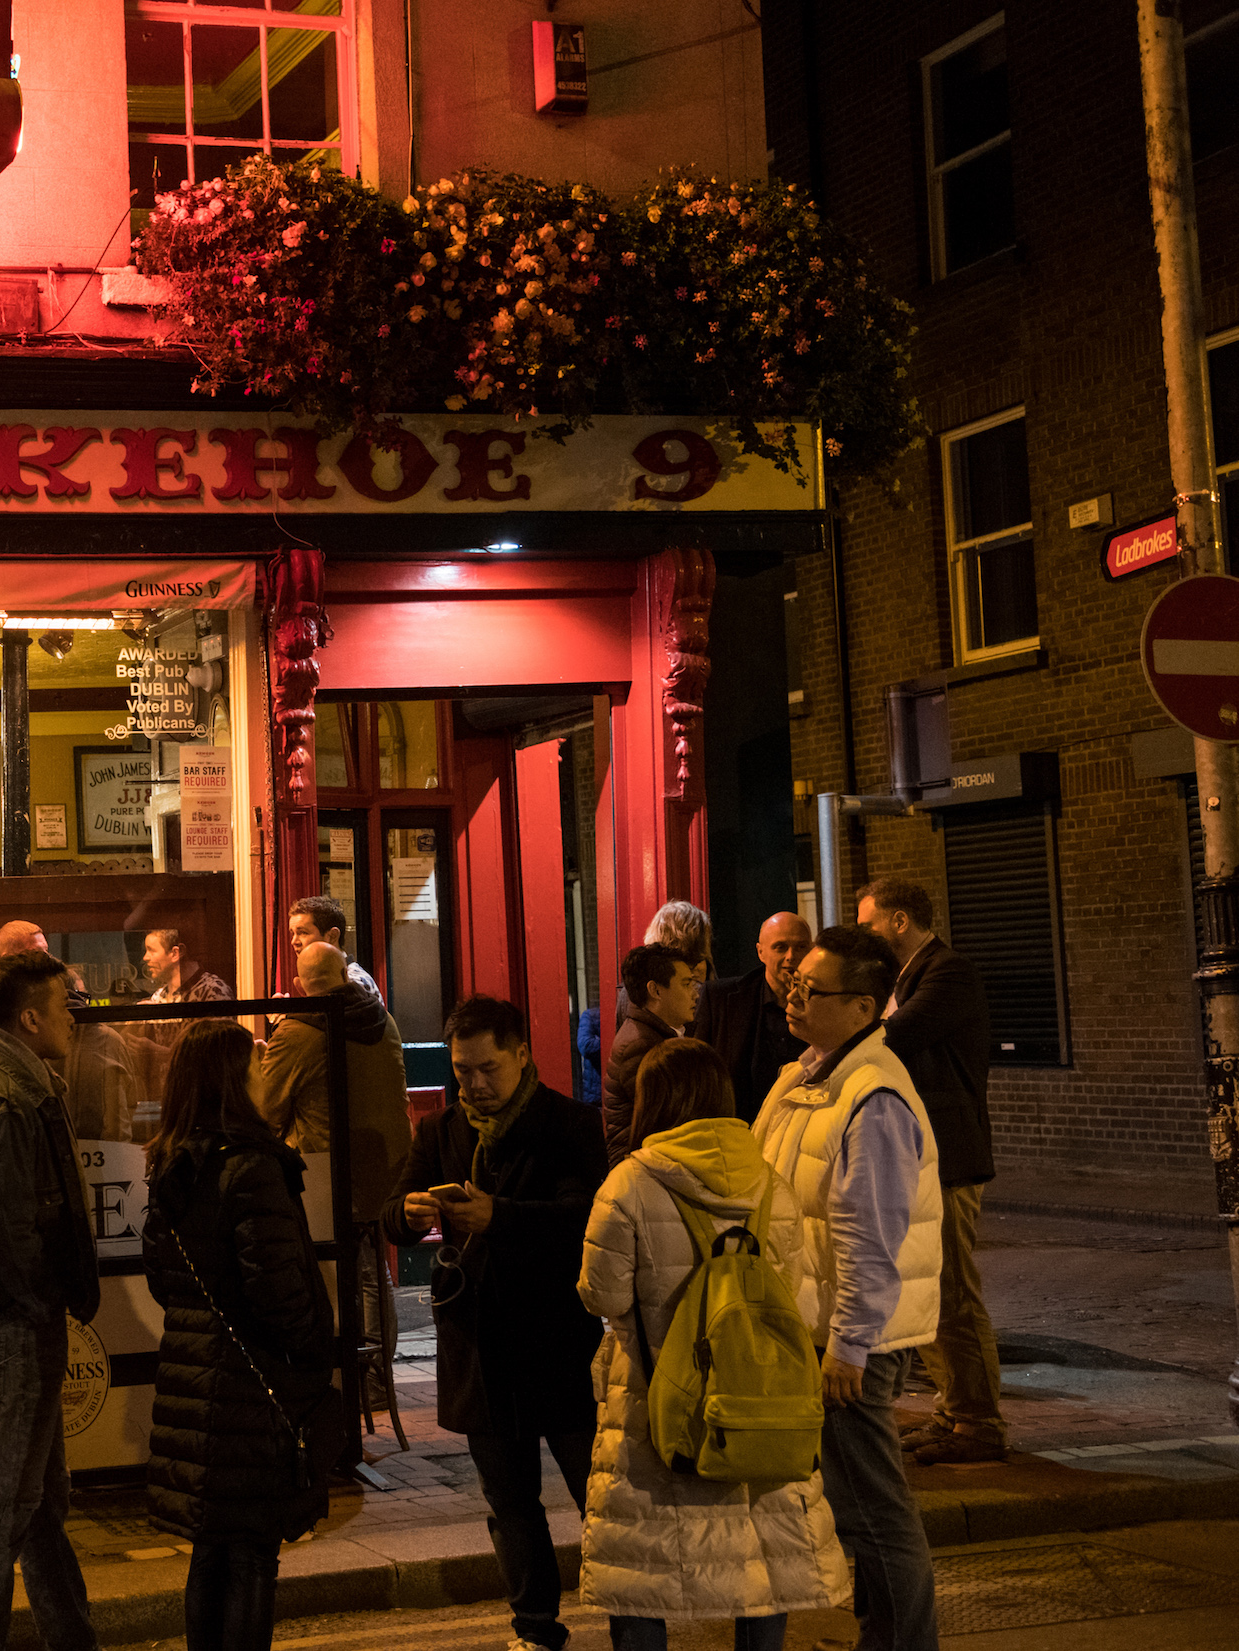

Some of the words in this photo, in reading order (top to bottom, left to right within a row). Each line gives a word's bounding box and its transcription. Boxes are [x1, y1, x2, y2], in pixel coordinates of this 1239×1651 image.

[555, 30, 585, 53] A1
[556, 53, 585, 63] ALARMS
[631, 430, 723, 501] 9
[1115, 530, 1173, 568] Ladbrokes
[125, 580, 204, 598] GUINNESS
[118, 648, 198, 661] AWARDED
[116, 665, 151, 678] Best
[154, 665, 185, 678] Pub
[130, 683, 189, 697] DUBLIN
[126, 700, 170, 714] Voted
[174, 700, 194, 715] By
[126, 717, 196, 730] Publicans
[89, 767, 116, 787] JOHN
[118, 762, 151, 778] JAMES
[184, 766, 200, 775] BAR
[202, 766, 226, 775] STAFF
[184, 776, 227, 787] REQUIRED
[110, 807, 133, 816] PURE
[94, 814, 139, 837] DUBLIN
[186, 827, 208, 835] LOUNGE
[210, 827, 228, 835] STAFF
[186, 835, 229, 846] REQUIRED
[89, 998, 111, 1007] AXI
[75, 1323, 100, 1355] BREWED
[65, 1361, 105, 1381] NESS
[63, 1381, 90, 1390] STOUT
[64, 1423, 82, 1433] ATE
[82, 1390, 102, 1423] DUBLIN
